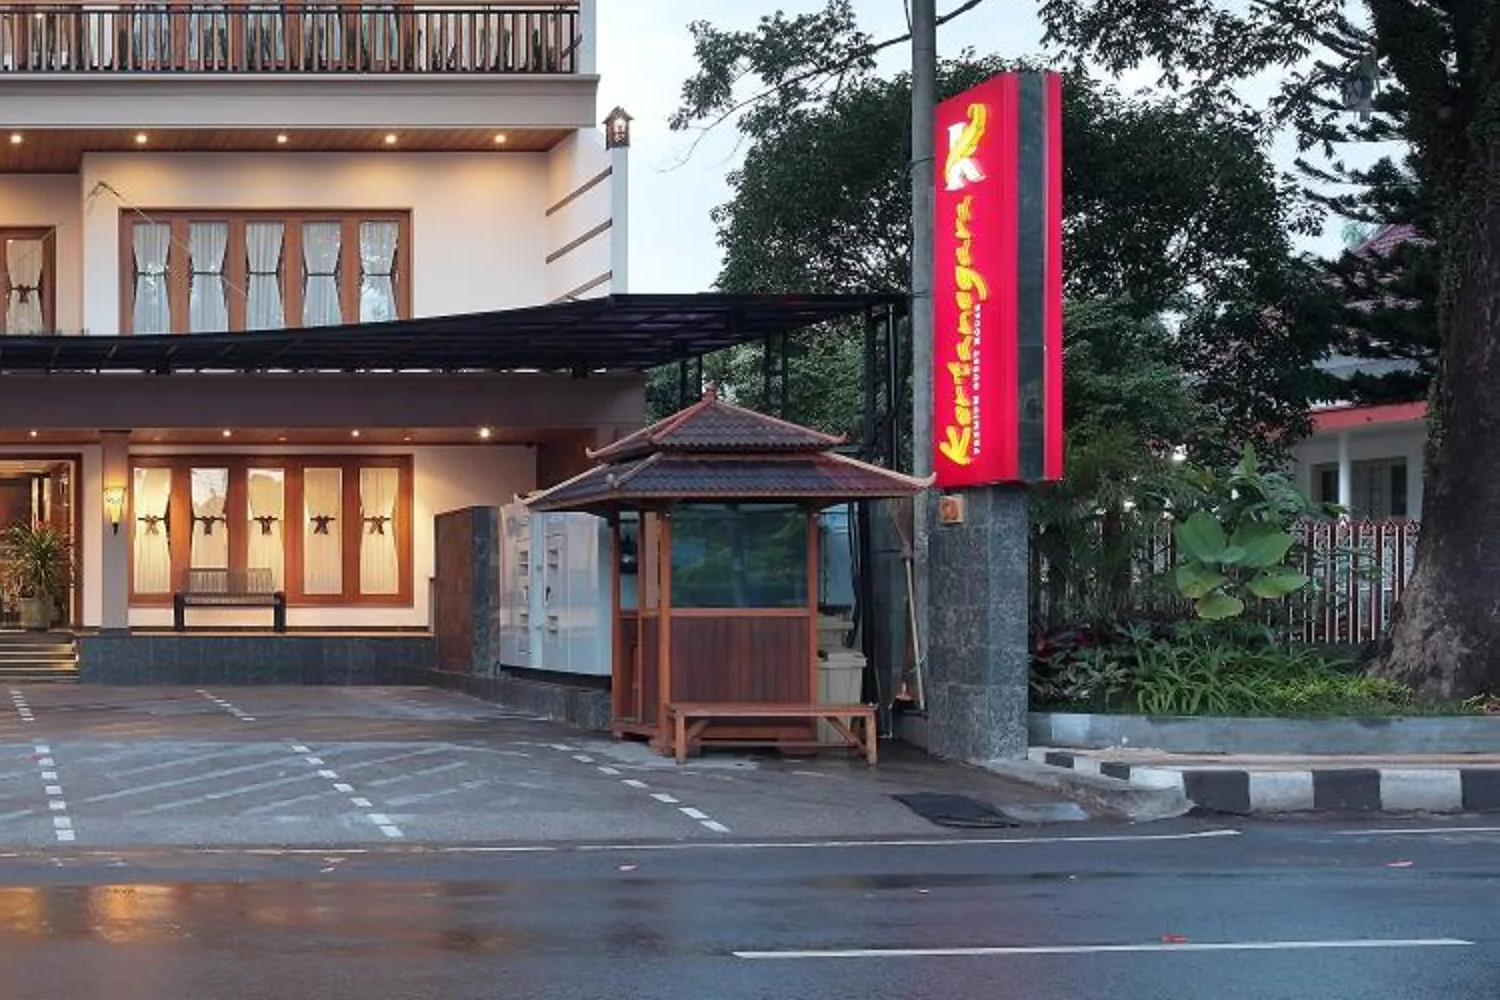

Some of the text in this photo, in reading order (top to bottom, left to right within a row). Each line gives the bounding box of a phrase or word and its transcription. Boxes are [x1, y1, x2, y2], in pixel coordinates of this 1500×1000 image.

[972, 304, 982, 454] PREMIUM GUEST HOUSE
